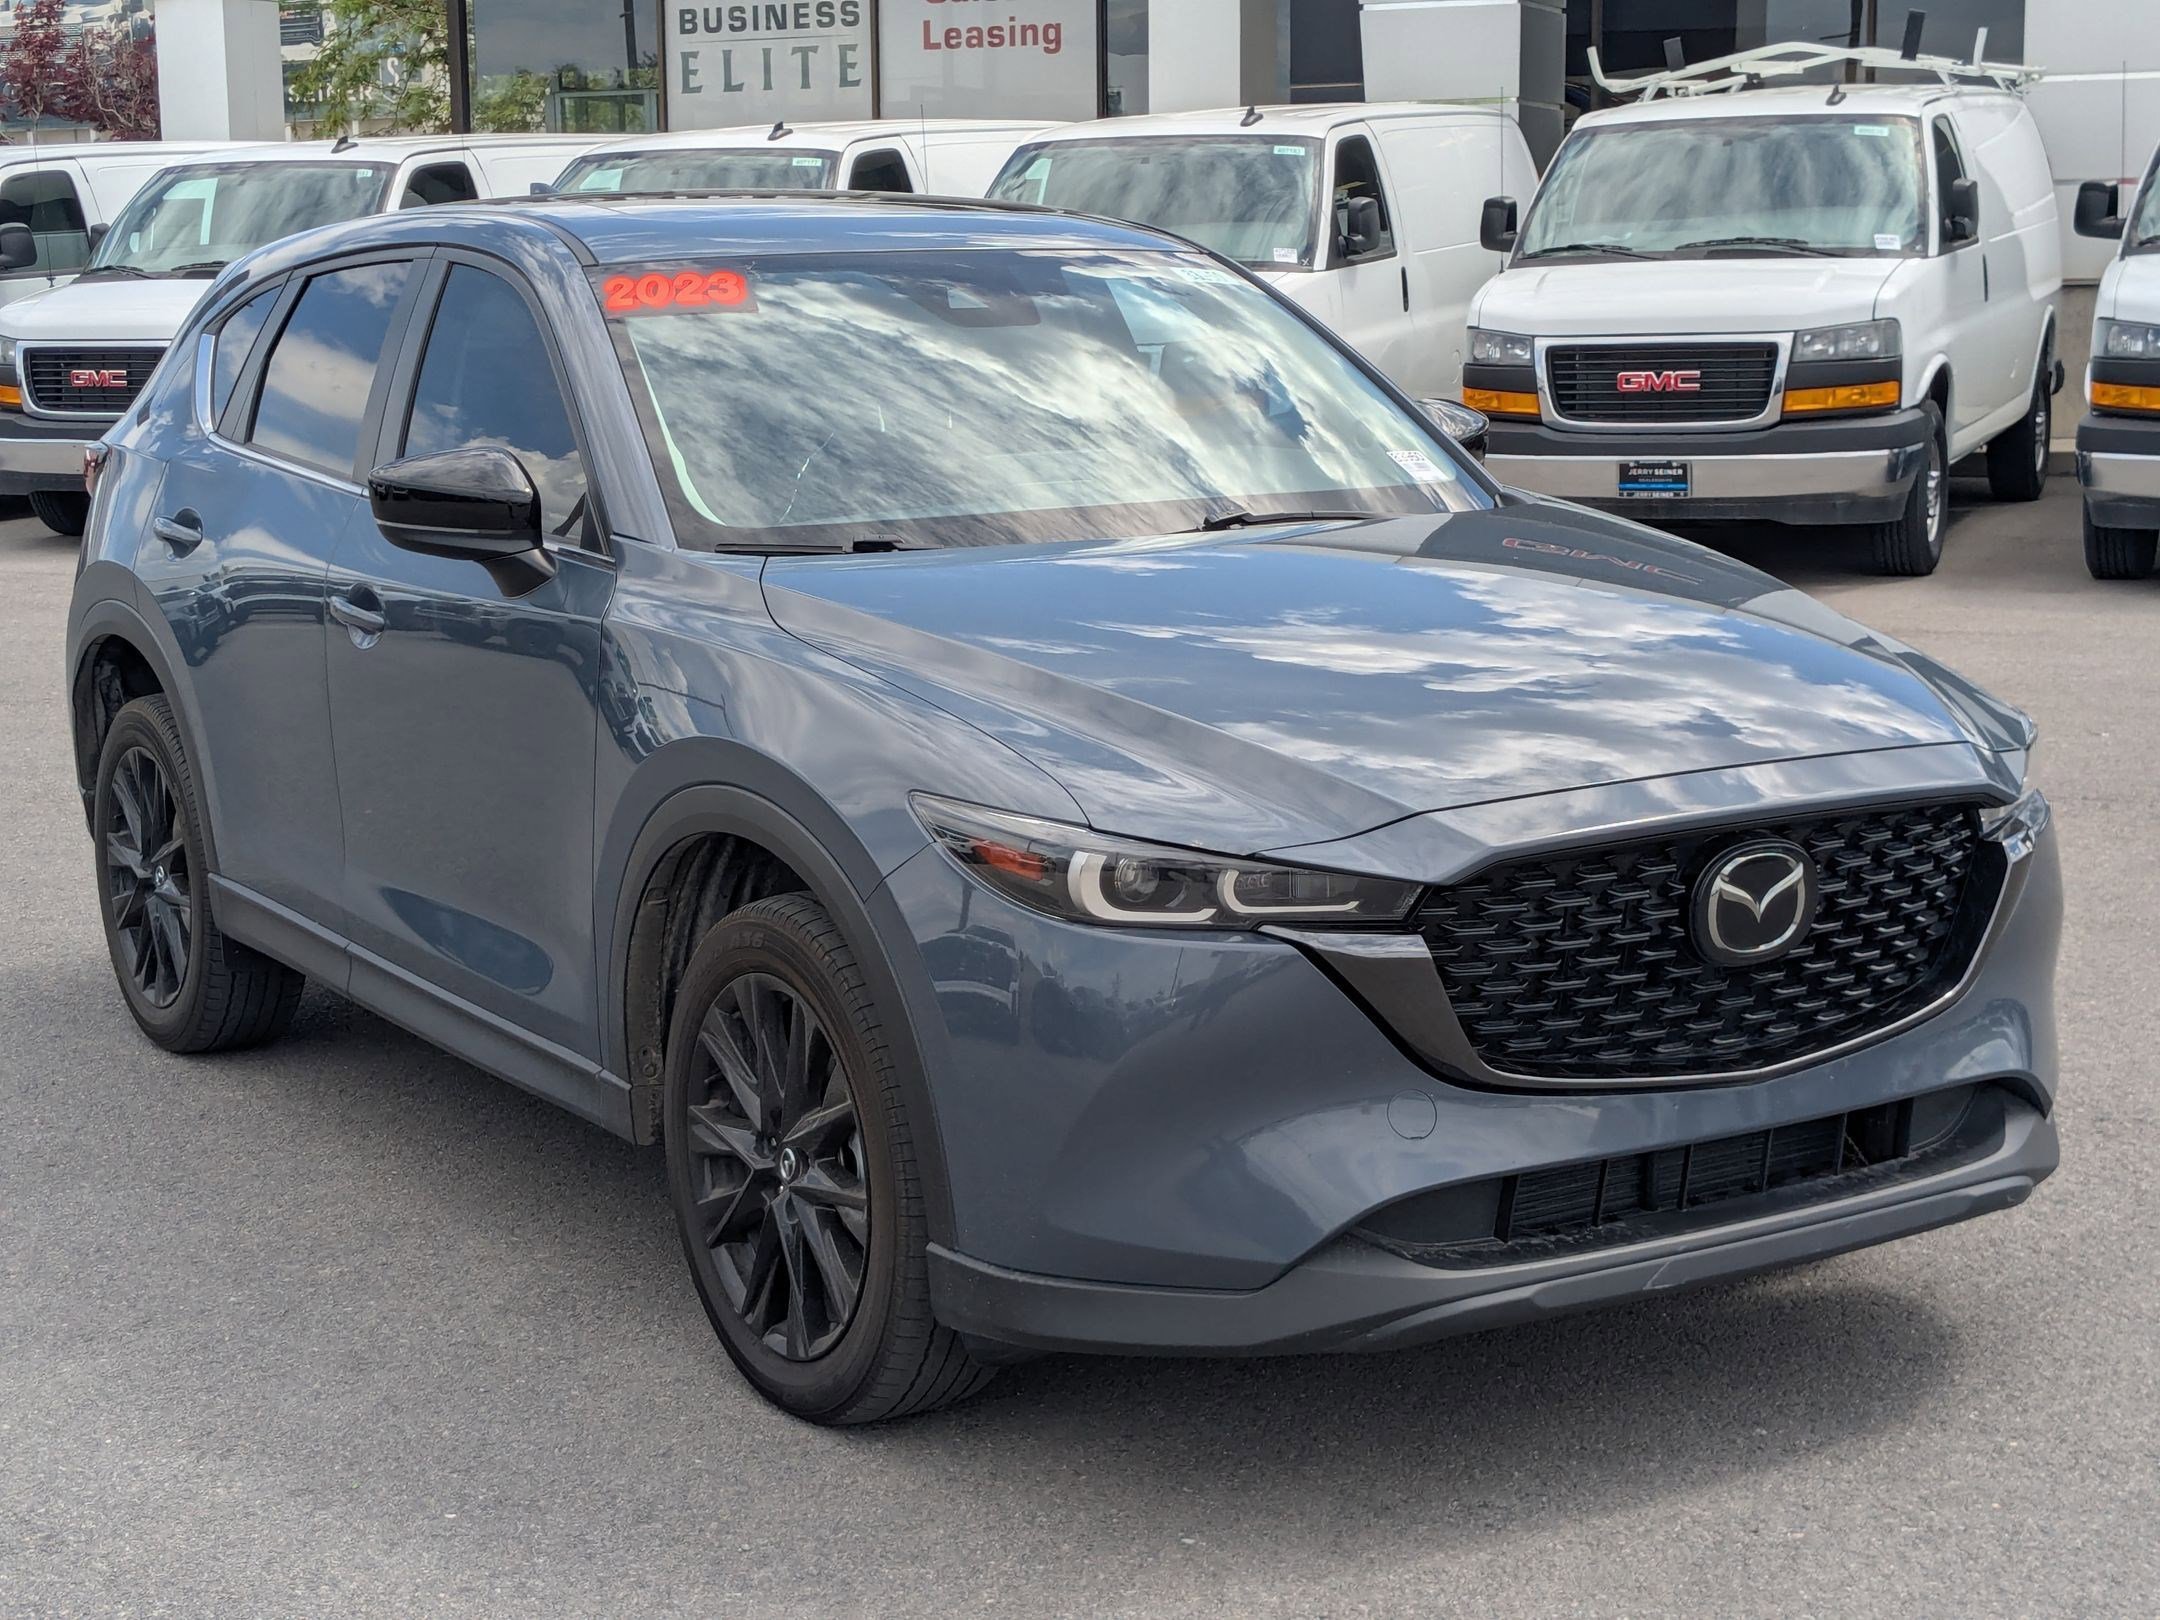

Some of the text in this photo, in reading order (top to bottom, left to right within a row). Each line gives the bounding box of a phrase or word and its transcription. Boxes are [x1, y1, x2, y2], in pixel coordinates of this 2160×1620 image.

[679, 0, 860, 35] BUSINESS
[922, 16, 1062, 54] Leasing
[680, 44, 862, 94] ELITE
[604, 271, 748, 311] 2023
[71, 369, 128, 387] GMC
[1617, 370, 1701, 392] GMC
